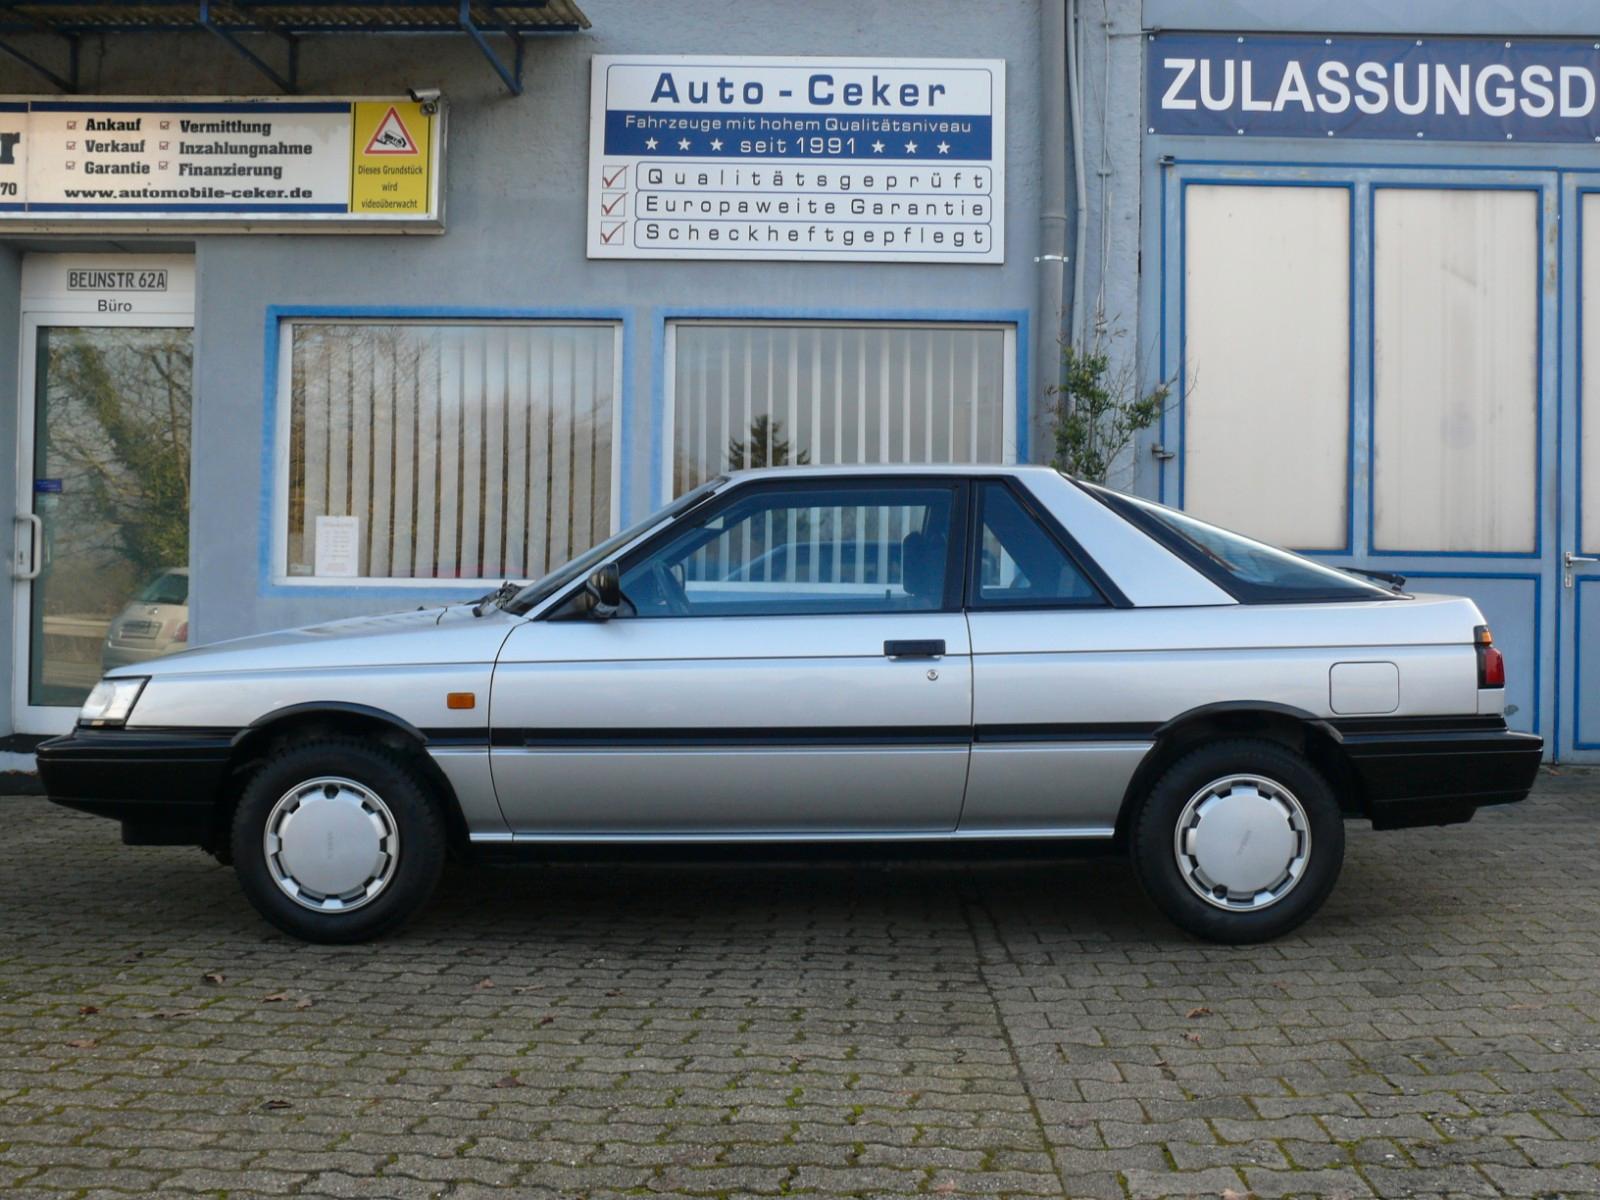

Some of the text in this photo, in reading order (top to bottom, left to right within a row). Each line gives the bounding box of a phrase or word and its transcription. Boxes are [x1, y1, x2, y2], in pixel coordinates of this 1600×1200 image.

[651, 72, 764, 105] Auto
[808, 74, 946, 107] Ceker
[1161, 57, 1596, 118] ZULASSUNGSD
[85, 118, 141, 131] Ankauf
[180, 120, 271, 136] Vermittlung
[625, 114, 971, 133] Fahrzeuge mit hohem Qualitätsniveau
[85, 139, 145, 153] Verkauf
[179, 141, 312, 158] Inzahlungnahme
[740, 137, 857, 155] seit 1991
[84, 161, 150, 174] Garantie
[178, 163, 282, 179] Finanzierung
[358, 165, 423, 175] Dieses Grundstück
[382, 182, 398, 192] wird
[648, 168, 984, 190] Qualitätsgeprüft
[64, 187, 312, 199] www.automobile-ceker.de
[361, 198, 418, 209] videoüberwacht
[646, 195, 984, 217] Europaweite Garantie
[646, 224, 984, 247] Scheckheftgepflegt
[138, 272, 165, 288] 62A
[97, 299, 132, 312] Büro
